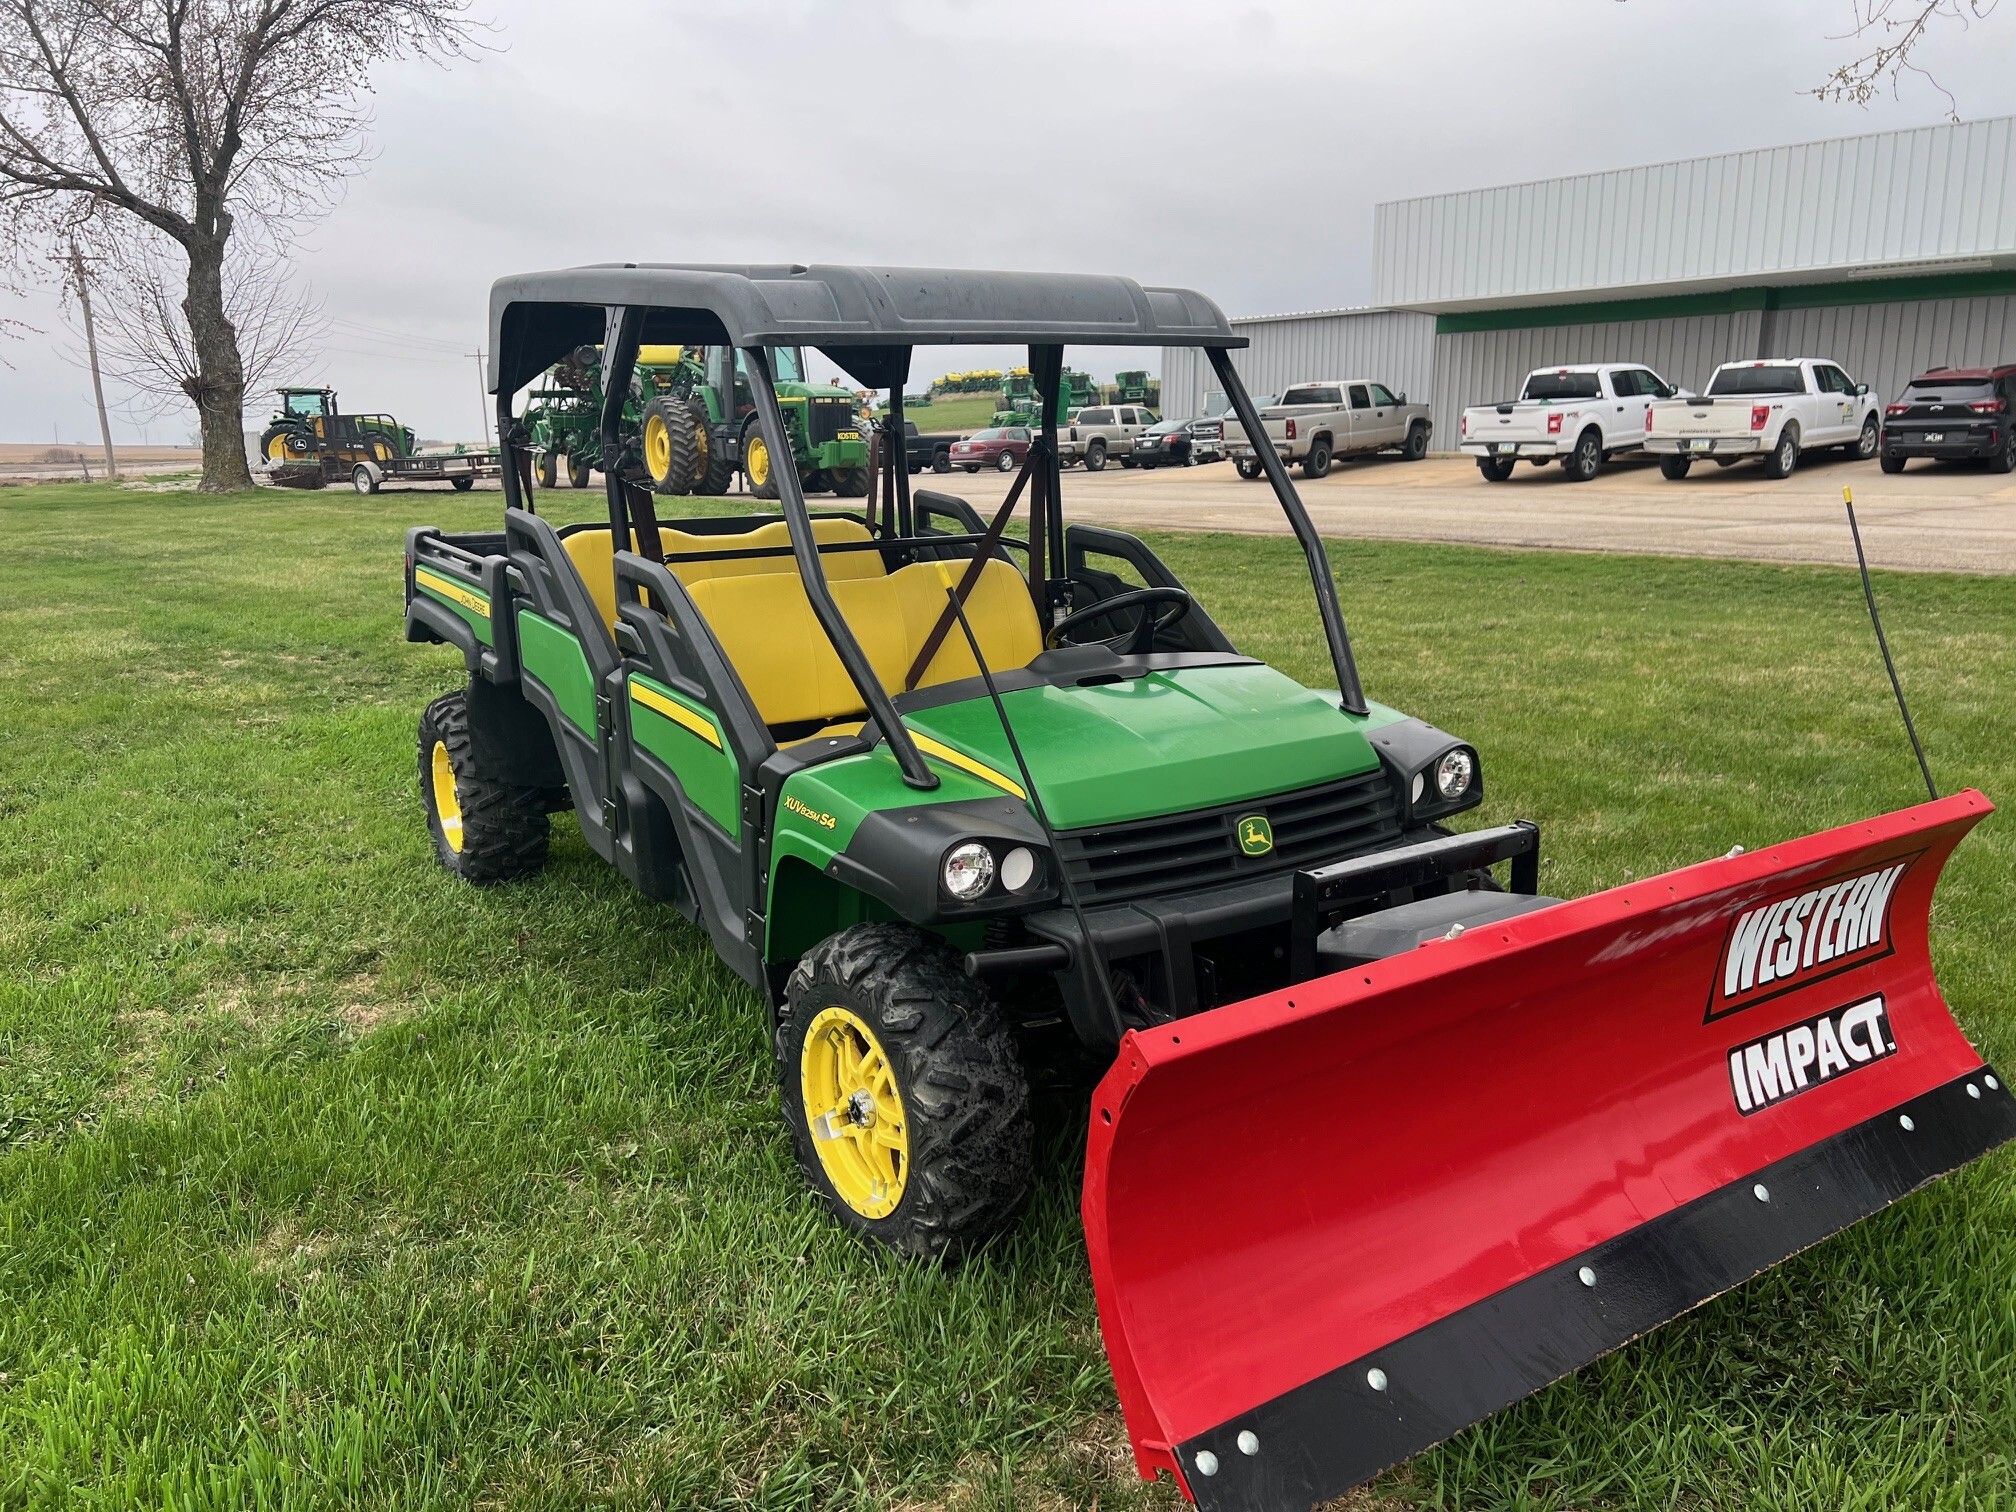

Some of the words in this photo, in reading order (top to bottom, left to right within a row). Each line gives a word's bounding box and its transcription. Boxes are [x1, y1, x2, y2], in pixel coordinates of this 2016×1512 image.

[837, 432, 860, 440] KOSTER
[819, 813, 837, 831] S4
[1724, 863, 1906, 998] WESTERN
